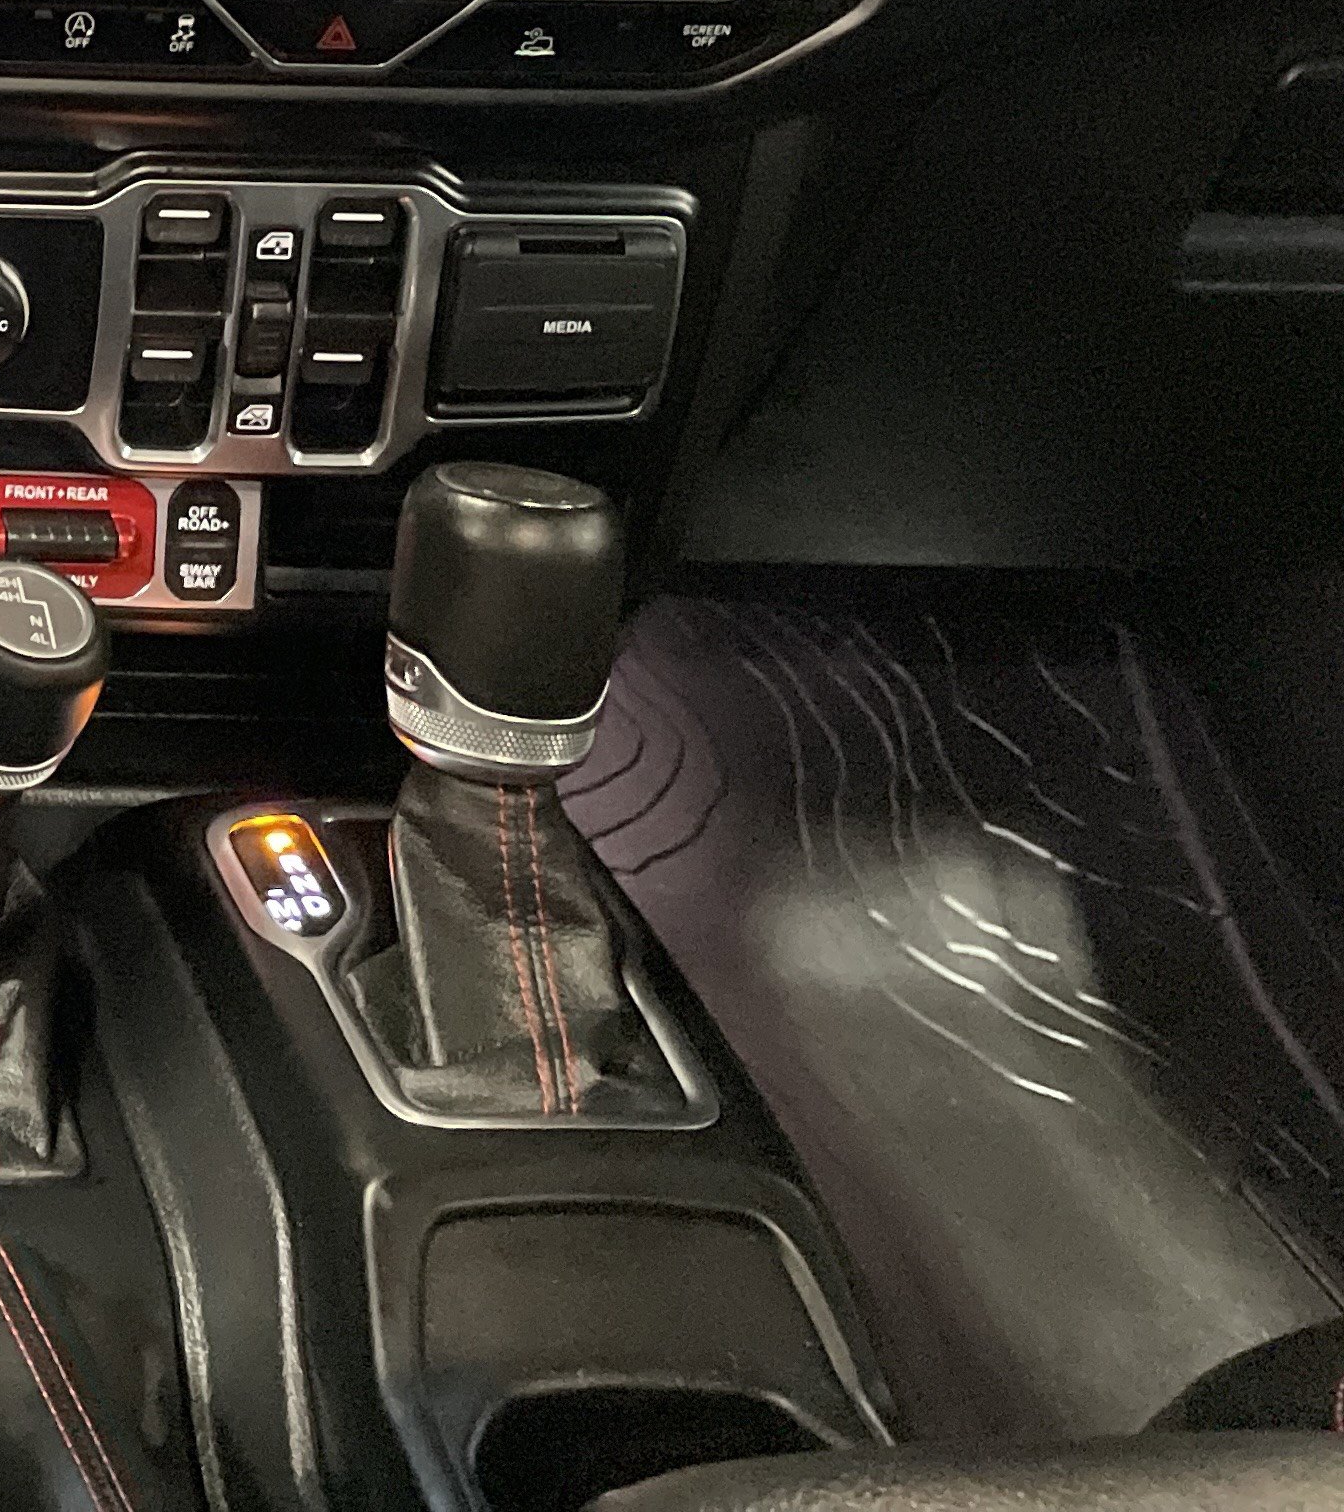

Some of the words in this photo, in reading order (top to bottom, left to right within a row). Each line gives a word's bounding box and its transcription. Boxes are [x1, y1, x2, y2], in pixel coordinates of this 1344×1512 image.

[683, 24, 731, 37] SCREEN
[65, 36, 91, 49] OFF
[169, 41, 194, 53] OFF
[691, 36, 717, 48] OFF
[542, 320, 592, 335] MEDIA
[189, 506, 218, 519] OFF
[179, 564, 222, 578] SWAY
[183, 576, 216, 589] BAR
[29, 615, 43, 627] N
[29, 632, 50, 645] 4L
[289, 873, 322, 895] N
[265, 897, 302, 919] M
[301, 895, 332, 917] D
